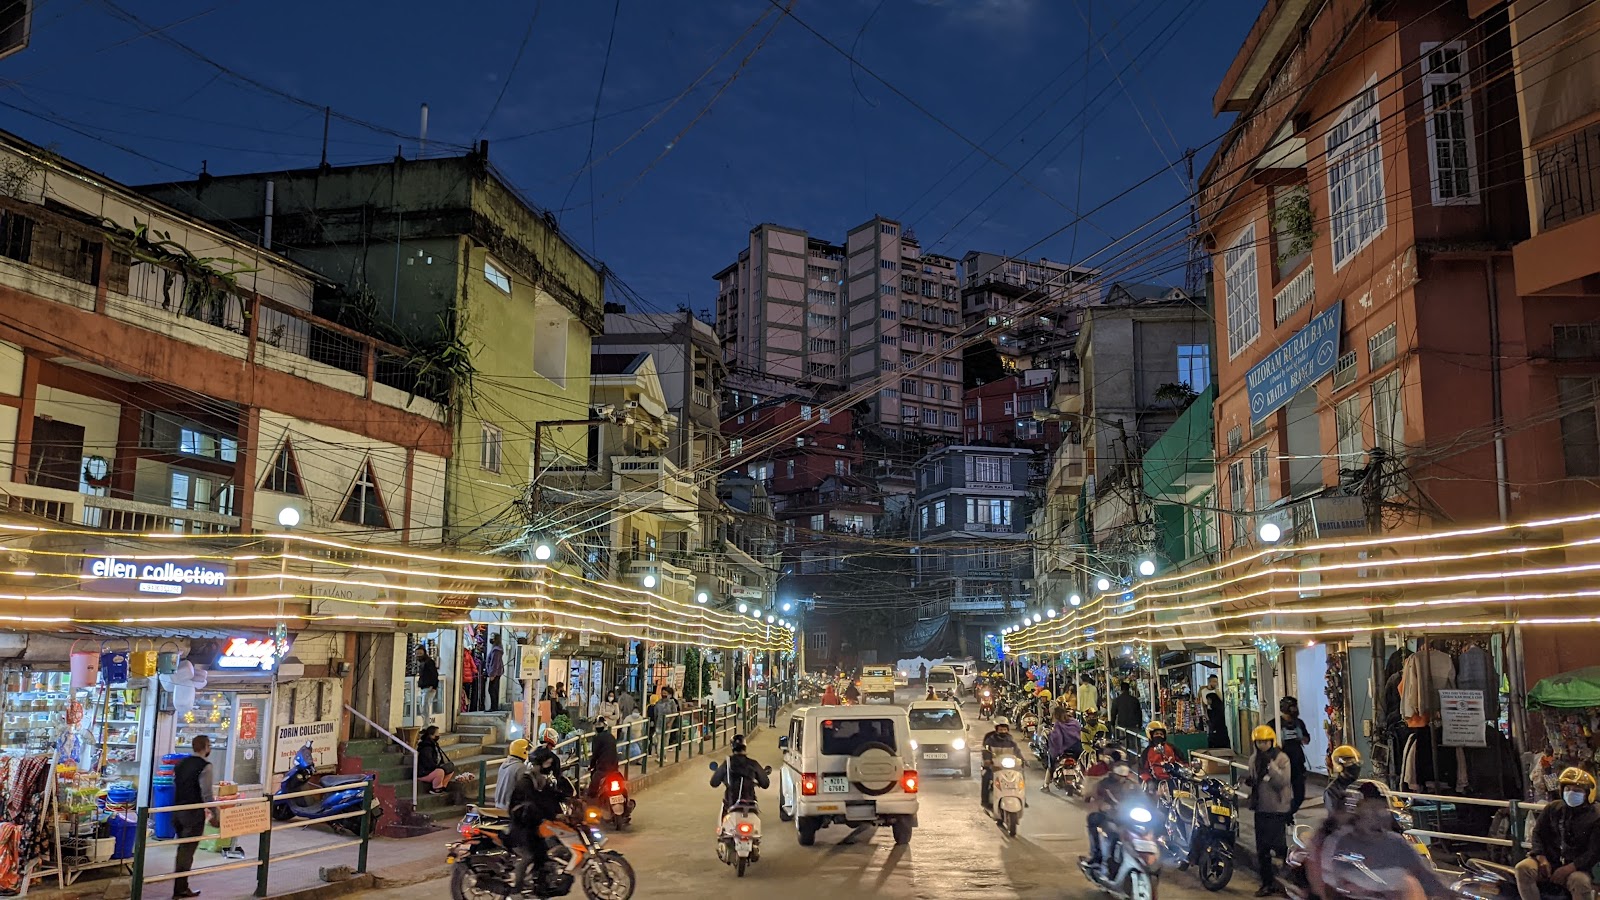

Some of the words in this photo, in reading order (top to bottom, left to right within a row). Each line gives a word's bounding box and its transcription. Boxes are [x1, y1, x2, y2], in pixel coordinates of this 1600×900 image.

[1249, 352, 1282, 390] MIZORAM
[1283, 332, 1310, 364] RURAL
[1311, 310, 1335, 344] BANK
[1266, 381, 1287, 406] KHATLA
[1290, 359, 1313, 388] BRANCH
[1319, 521, 1340, 530] KHATLA
[1342, 520, 1364, 528] BRANCH
[92, 558, 137, 578] ellen
[143, 563, 225, 586] collection
[280, 727, 298, 738] ZORIN
[300, 722, 333, 736] COLLECTION
